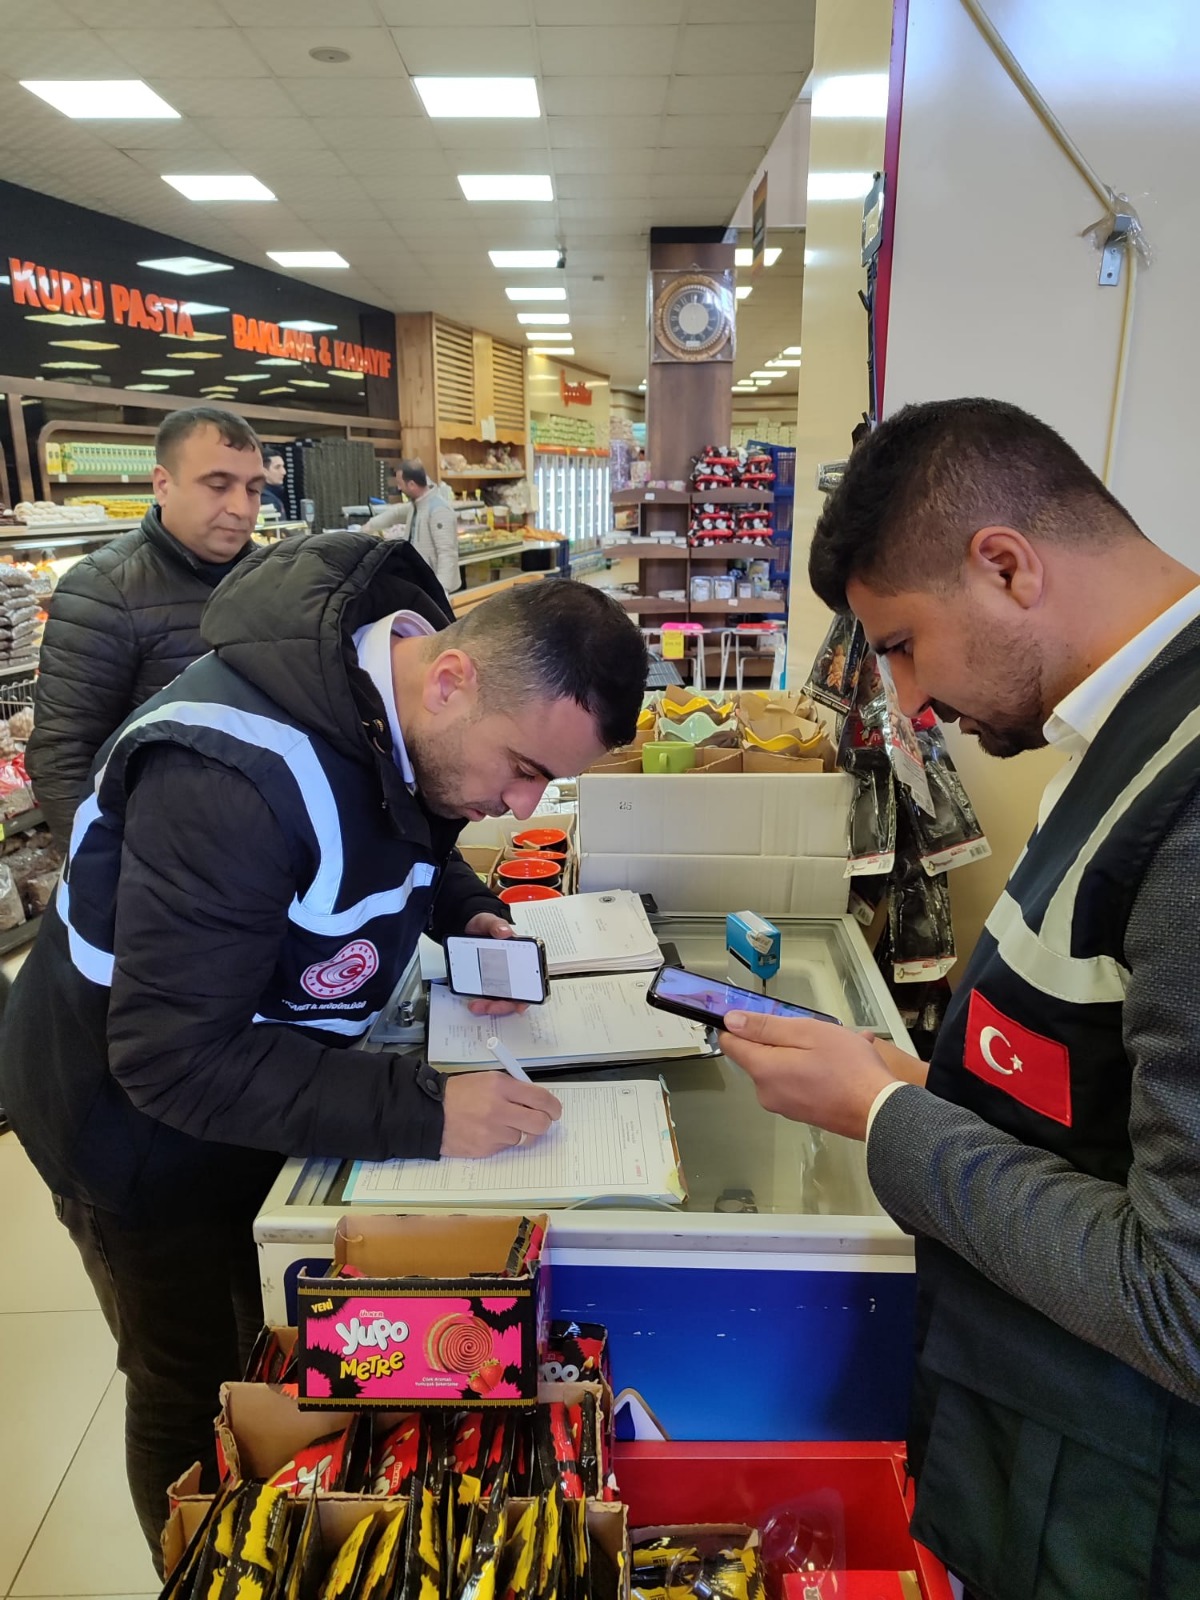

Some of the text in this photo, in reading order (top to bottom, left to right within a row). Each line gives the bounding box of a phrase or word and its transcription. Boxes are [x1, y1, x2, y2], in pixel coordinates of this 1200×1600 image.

[8, 257, 195, 338] KURU PASTA
[232, 313, 392, 378] BAKLAVA & KADAYIF
[310, 1297, 334, 1313] YENİ
